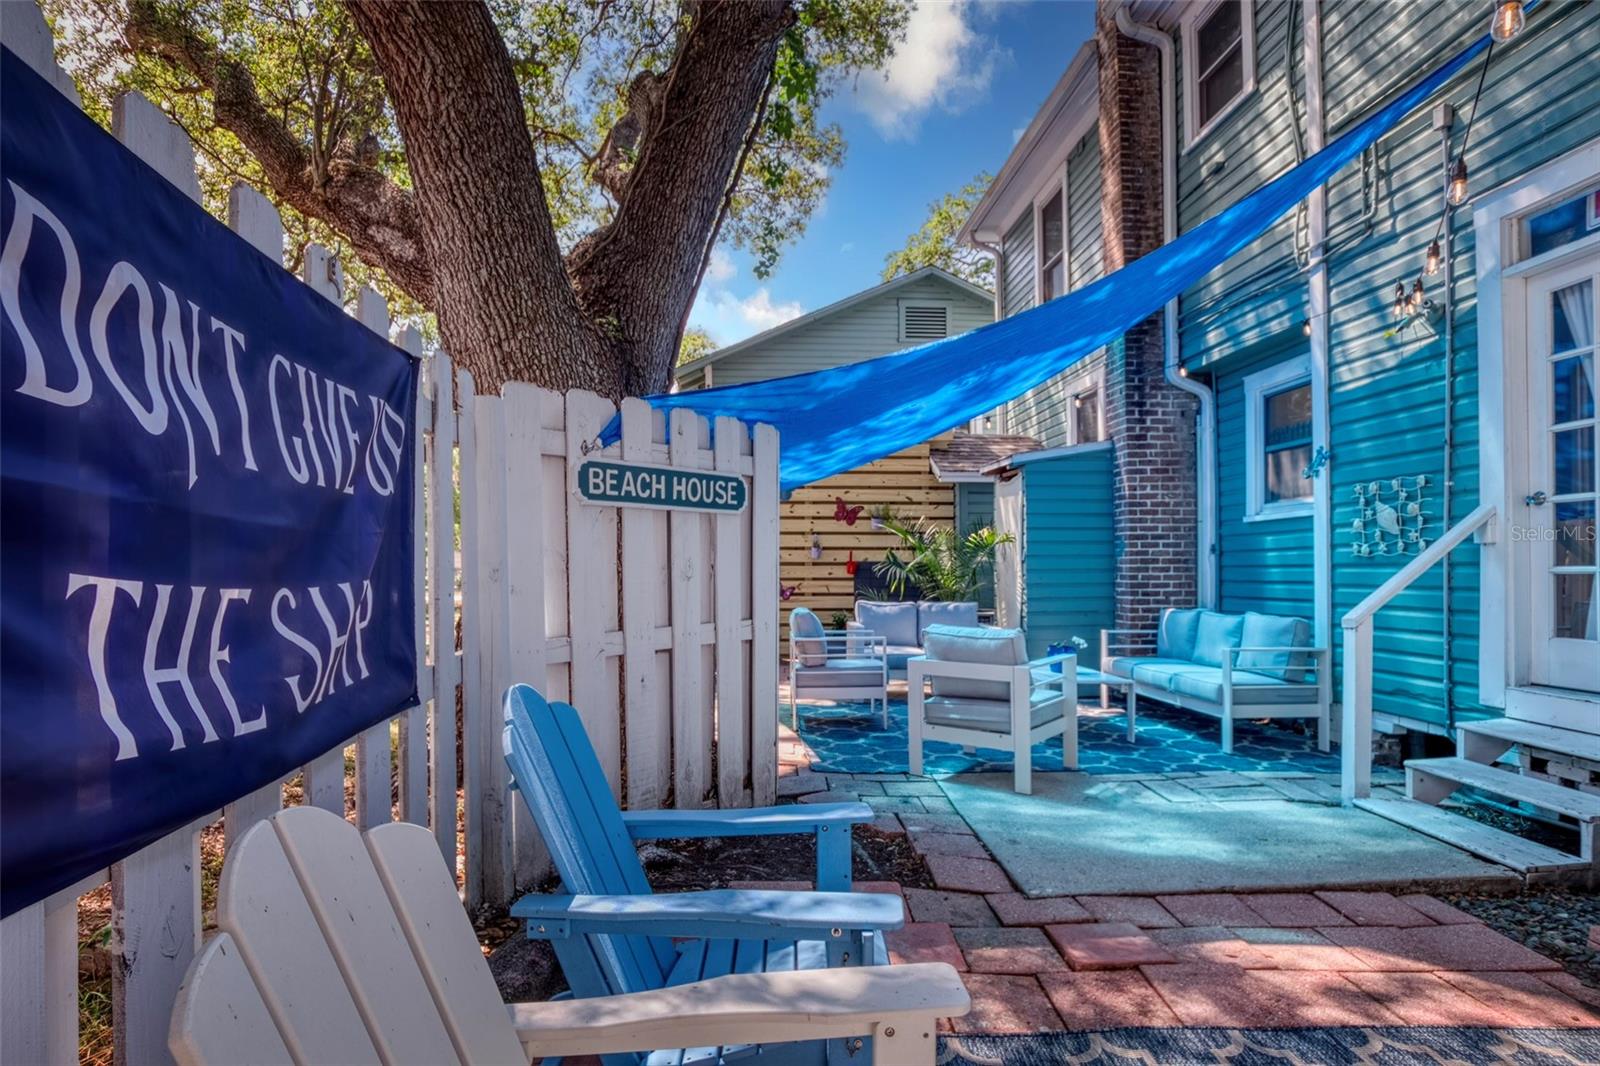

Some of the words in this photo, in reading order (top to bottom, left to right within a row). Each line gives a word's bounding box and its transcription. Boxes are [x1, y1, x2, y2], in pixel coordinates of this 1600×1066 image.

[0, 178, 258, 490] DONT
[268, 354, 361, 495] GIVE
[588, 467, 666, 499] BEACH
[672, 476, 738, 505] HOUSE
[65, 573, 267, 761] THE
